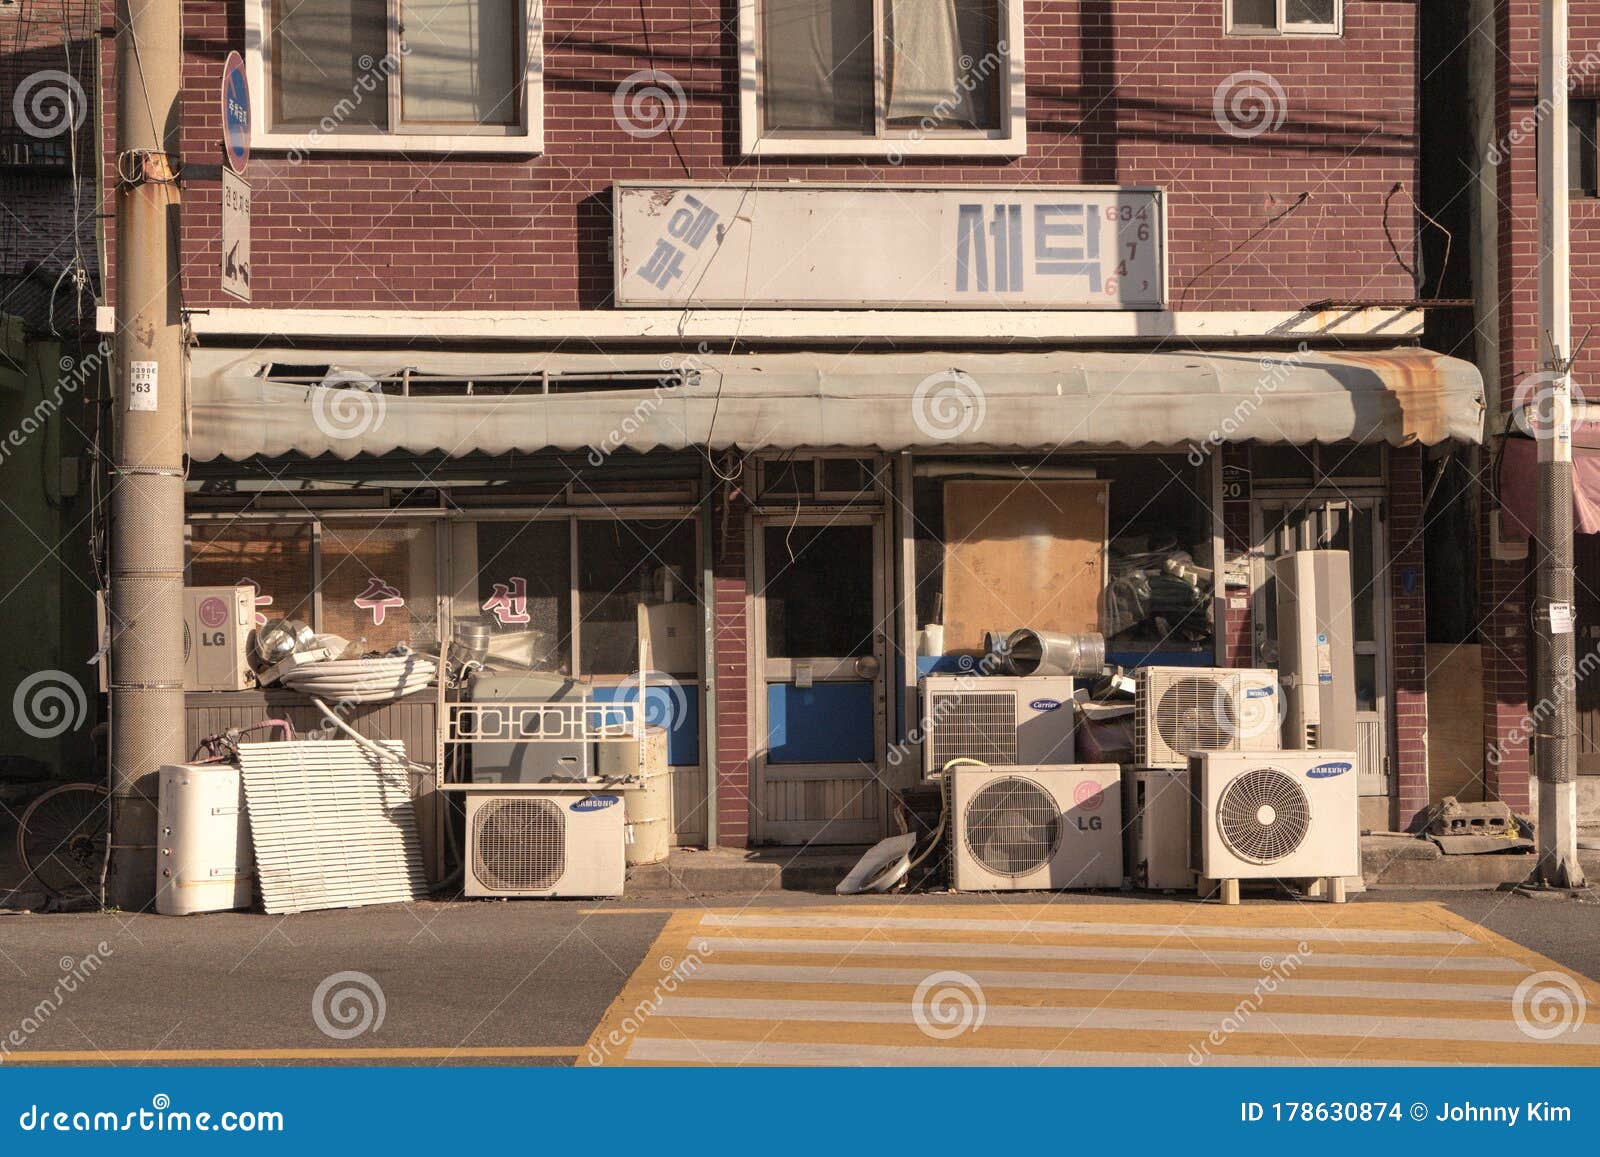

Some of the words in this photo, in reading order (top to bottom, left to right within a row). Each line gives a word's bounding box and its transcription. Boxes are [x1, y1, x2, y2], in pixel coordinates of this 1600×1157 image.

[957, 204, 1102, 292] 세탁
[136, 383, 151, 392] 63
[354, 578, 404, 626] 수
[482, 577, 530, 623] 선
[203, 632, 225, 646] LG
[1033, 700, 1058, 709] Carrier
[1077, 816, 1102, 831] LG
